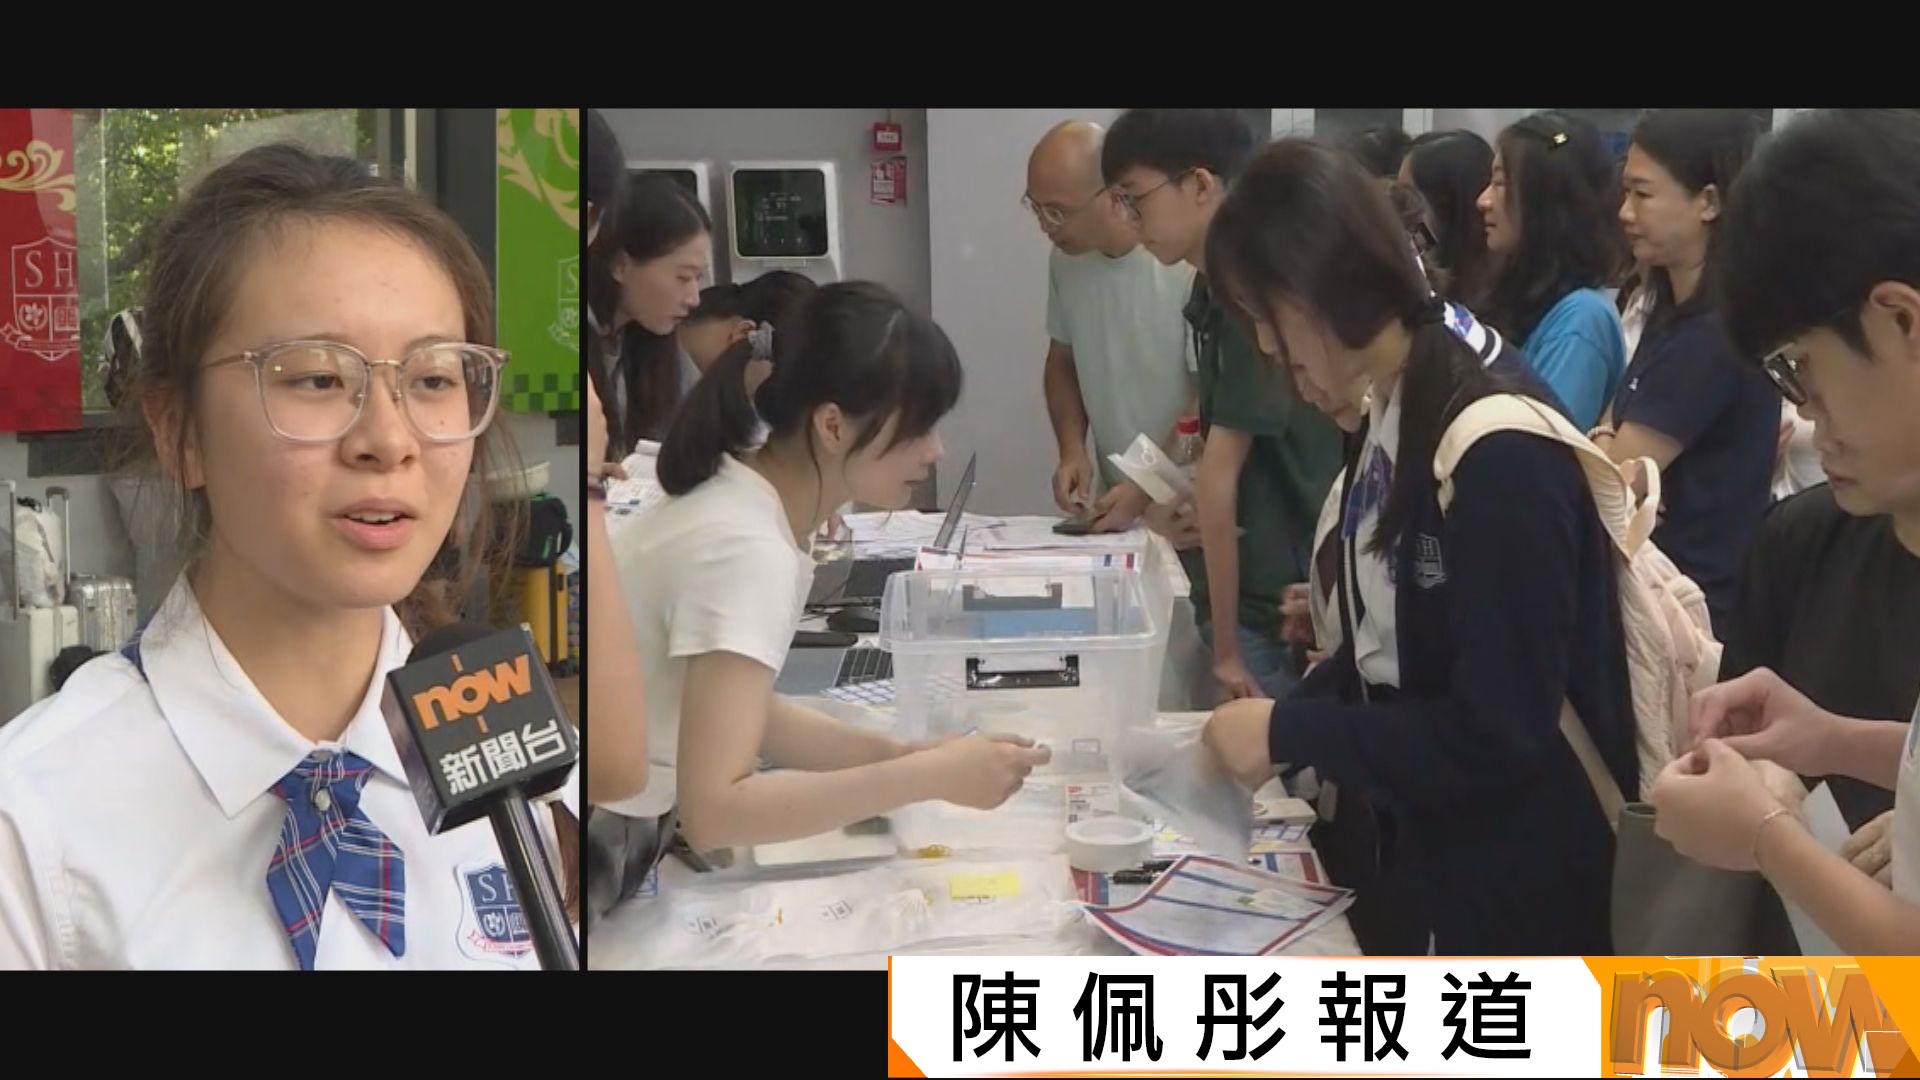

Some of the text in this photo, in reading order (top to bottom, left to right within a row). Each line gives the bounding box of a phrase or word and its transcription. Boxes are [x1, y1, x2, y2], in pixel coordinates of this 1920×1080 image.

[412, 653, 533, 730] now
[439, 719, 567, 796] 新聞台
